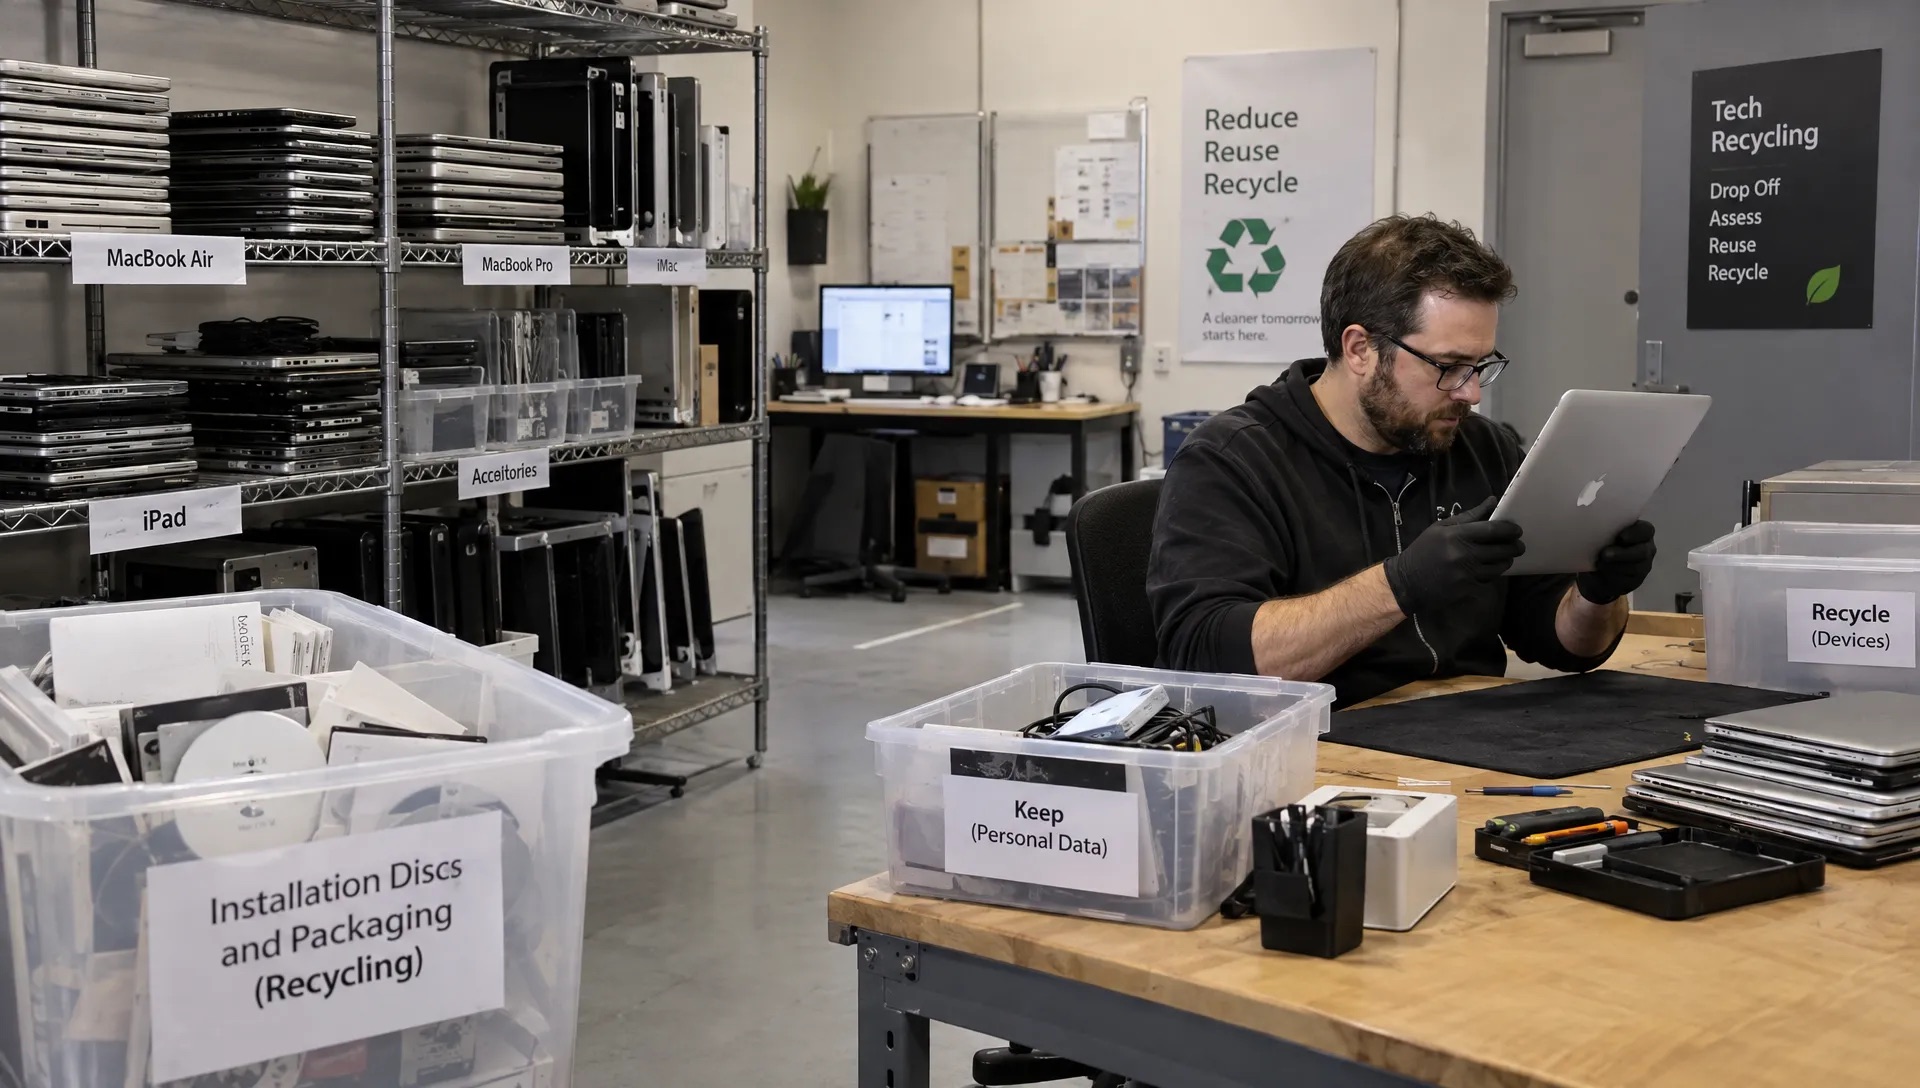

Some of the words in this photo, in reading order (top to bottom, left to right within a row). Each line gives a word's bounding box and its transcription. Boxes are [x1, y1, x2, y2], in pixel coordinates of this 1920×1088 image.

[1205, 106, 1299, 131] Reduce
[1711, 96, 1762, 122] Tech
[1711, 123, 1819, 155] Recycling
[1205, 141, 1280, 163] Reuse
[1204, 170, 1299, 200] Recycle
[1710, 182, 1750, 202] Drop
[1754, 177, 1781, 196] Off
[1709, 210, 1762, 227] Assess
[1709, 237, 1757, 254] Reuse
[107, 248, 186, 268] MacBook
[190, 249, 214, 268] Air
[482, 256, 533, 272] MacBook
[535, 257, 553, 272] Pro
[657, 258, 678, 273] iMac
[1708, 263, 1769, 284] Recycle
[1202, 312, 1212, 324] A
[1215, 312, 1258, 324] cleaner
[1262, 314, 1321, 325] tomorrow
[1203, 329, 1235, 341] starts
[1238, 329, 1268, 341] here.
[143, 506, 187, 531] iPad
[1812, 603, 1890, 627] Recycle
[1812, 629, 1890, 651] (Devices)
[1015, 800, 1064, 827] Keep
[971, 822, 1053, 850] (Personal
[1058, 832, 1108, 859] Data)
[211, 873, 380, 924] Installation
[390, 858, 463, 890] Discs
[221, 929, 281, 967] and
[292, 903, 452, 952] Packaging
[254, 945, 423, 1009] (Recycling)
